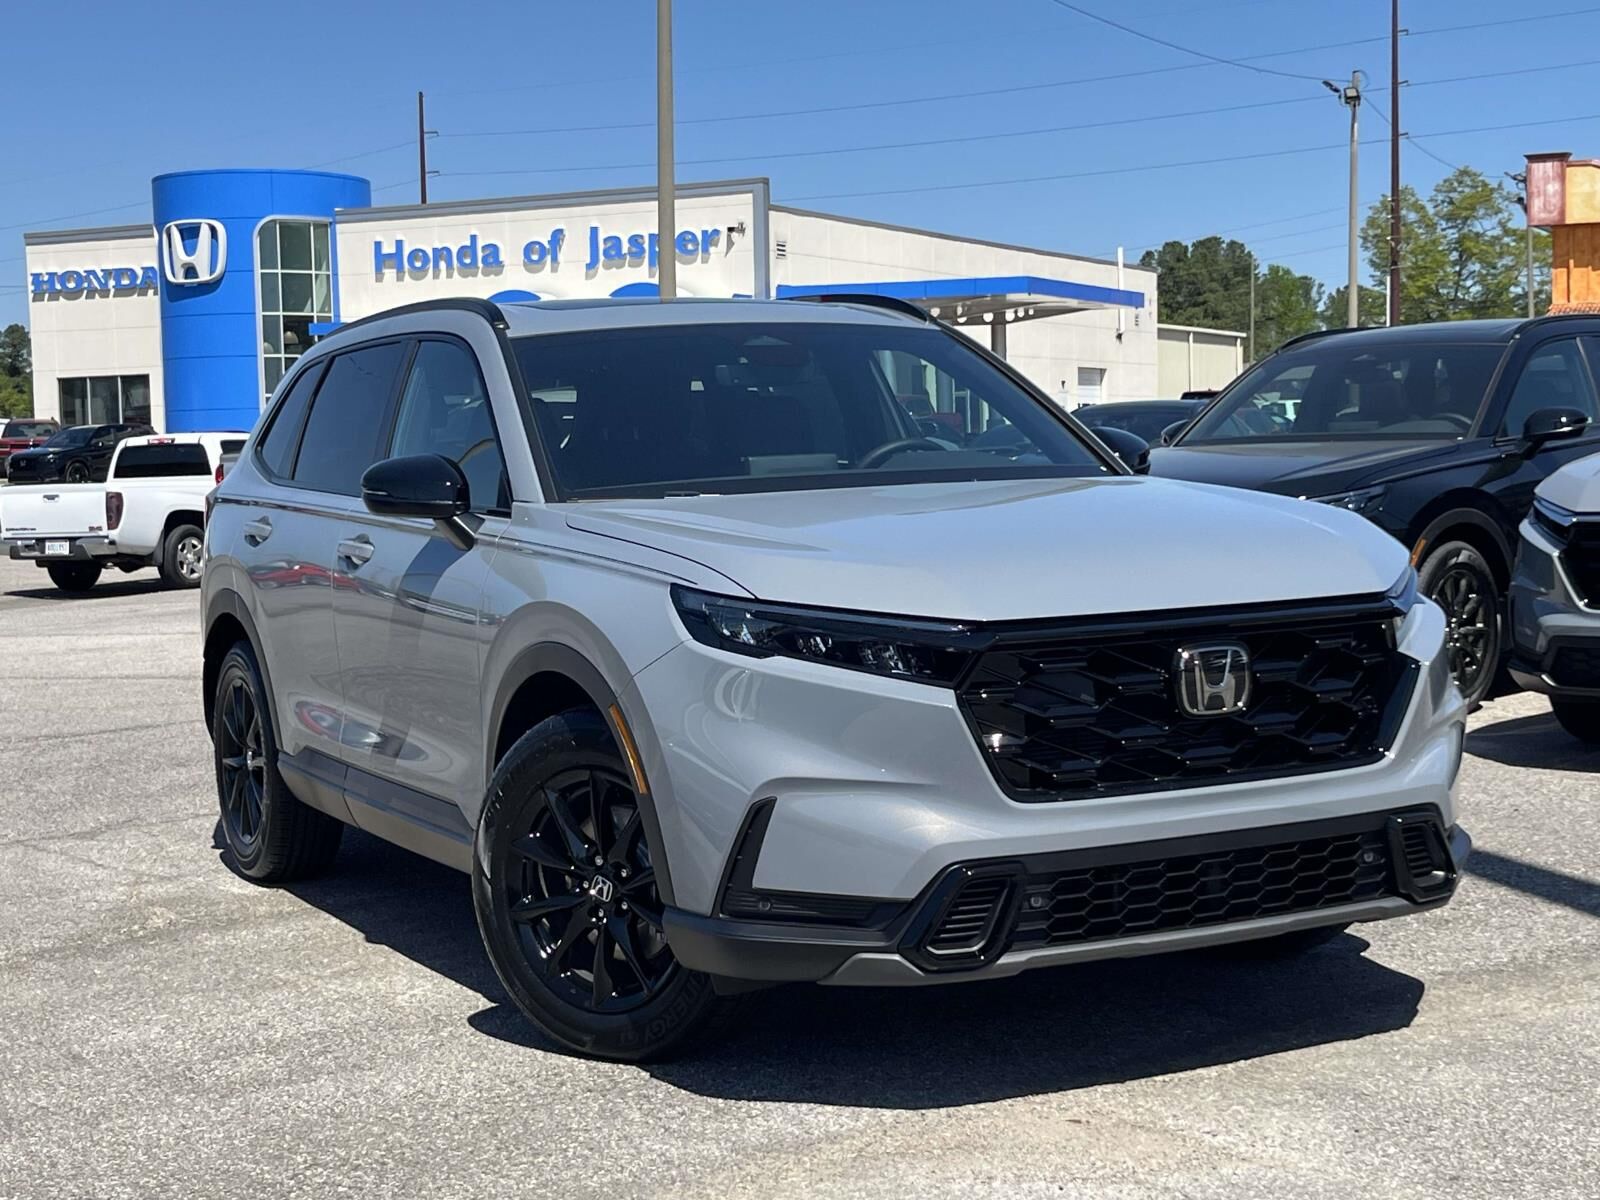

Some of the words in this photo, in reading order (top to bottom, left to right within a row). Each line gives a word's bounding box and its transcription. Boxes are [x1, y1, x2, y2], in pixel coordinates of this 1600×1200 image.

[373, 234, 504, 274] Honda
[523, 227, 564, 265] of
[30, 266, 159, 294] HONDA
